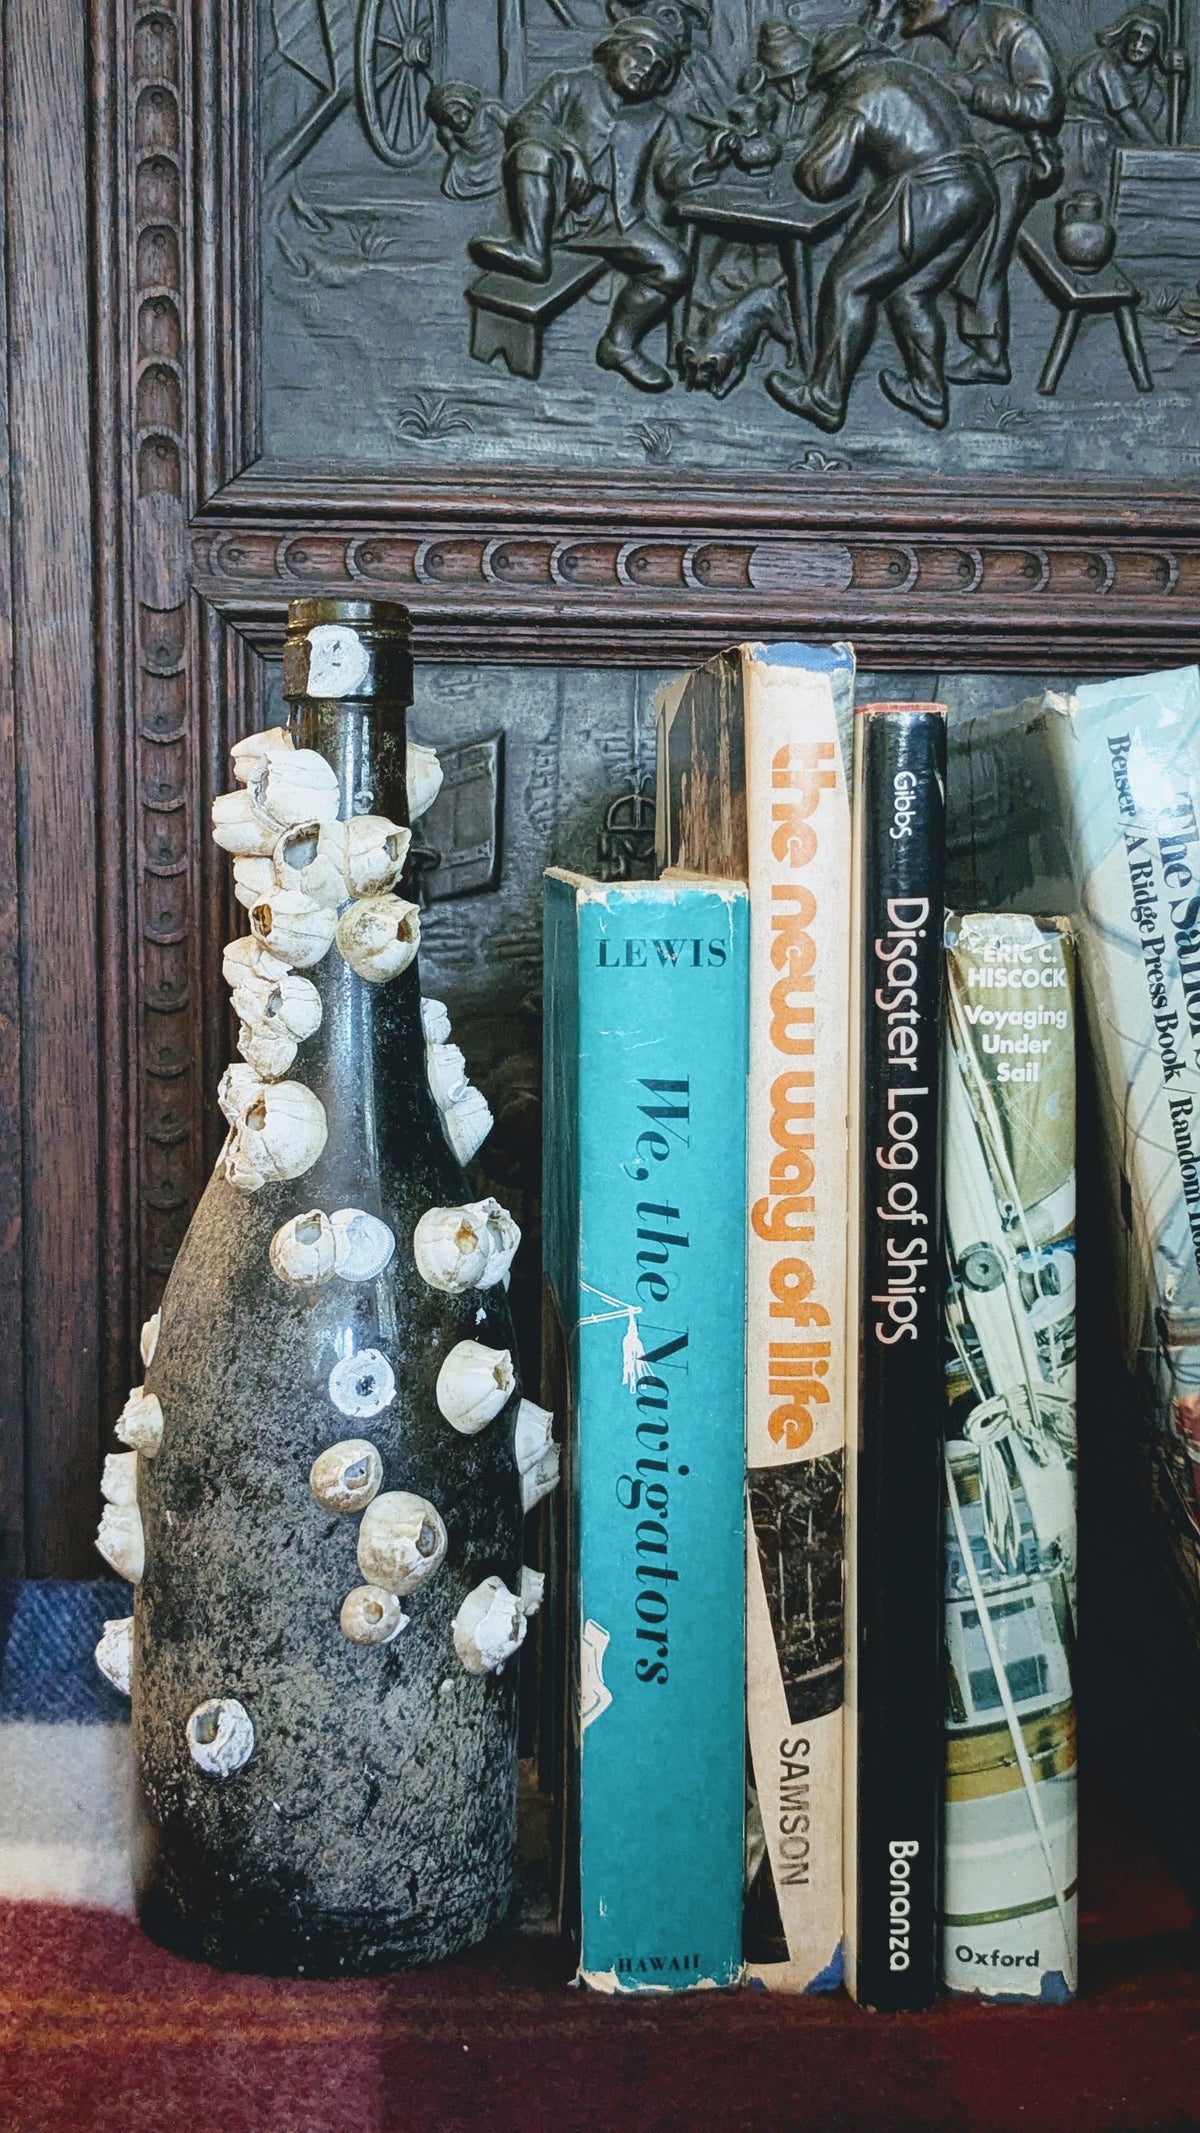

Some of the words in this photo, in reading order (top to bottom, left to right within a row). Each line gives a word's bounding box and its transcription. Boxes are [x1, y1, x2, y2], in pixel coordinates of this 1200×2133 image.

[771, 742, 837, 868] the
[889, 770, 918, 840] Gibbs
[1158, 791, 1200, 889] The
[1124, 832, 1148, 855] A
[1129, 858, 1158, 934] Ridge
[595, 938, 727, 967] LEWIS
[769, 885, 818, 1056] new
[874, 897, 930, 1072] Disaster
[967, 967, 1067, 989] HISCOCK
[983, 943, 1033, 964] ERIC
[1039, 943, 1057, 964] C.
[1140, 934, 1168, 1010] Press
[964, 1004, 1067, 1030] Voyaging
[981, 1033, 1052, 1055] Under
[1154, 1010, 1187, 1084] Book
[996, 1062, 1040, 1083] Sail
[623, 1075, 690, 1182] We,
[751, 1072, 816, 1242] way
[875, 1087, 929, 1170] Log
[1168, 1096, 1200, 1206] Random
[876, 1182, 929, 1226] of
[636, 1200, 690, 1302] the
[769, 1258, 832, 1328] of
[871, 1237, 928, 1345] Ships
[767, 1341, 832, 1450] life
[616, 1318, 690, 1685] Navigators
[779, 1738, 811, 1885] SAMSON
[888, 1840, 920, 1971] Bonanza
[618, 1953, 701, 1973] HAWAII
[955, 1944, 1040, 1967] Oxford
